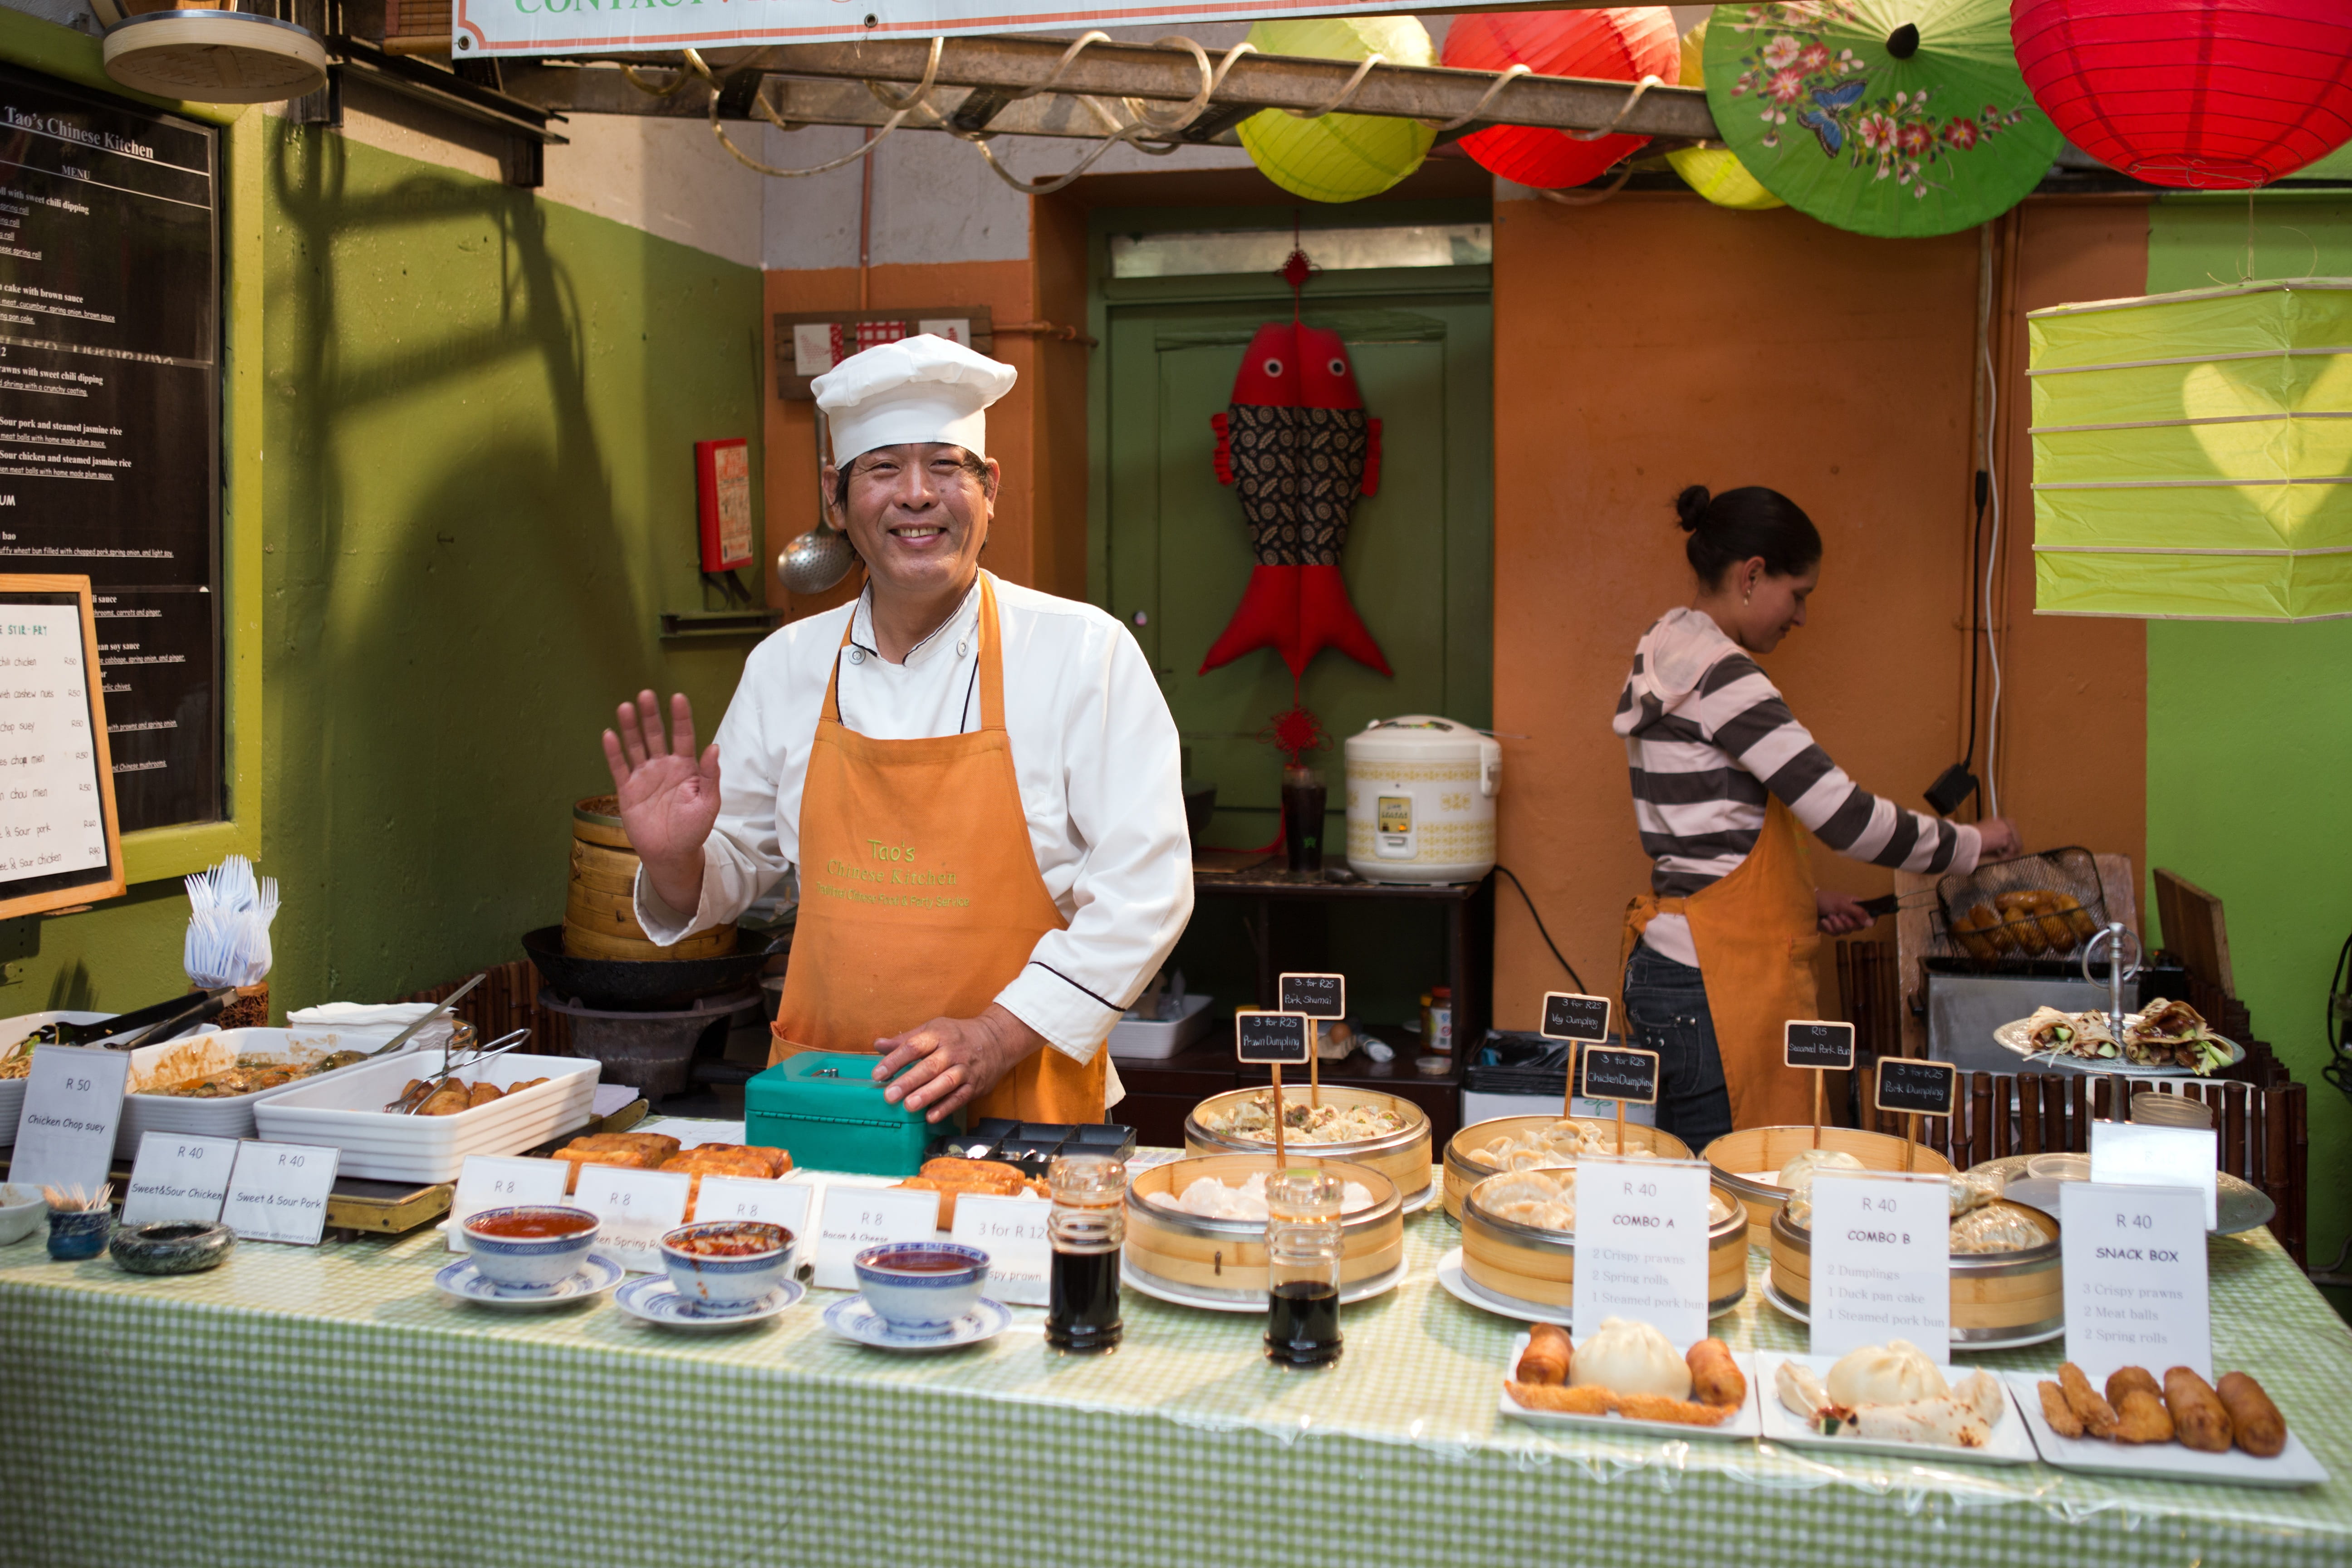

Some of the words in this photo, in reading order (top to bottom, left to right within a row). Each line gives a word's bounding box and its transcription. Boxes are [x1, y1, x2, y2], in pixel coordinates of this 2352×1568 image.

[5, 106, 43, 130] Tao's
[47, 118, 100, 145] Chinese
[105, 132, 154, 159] Kitchen
[62, 165, 90, 180] MENU
[8, 190, 24, 199] with
[26, 194, 44, 204] sweet
[46, 197, 61, 207] chili
[63, 201, 89, 215] dipping
[5, 284, 21, 294] cake
[23, 287, 39, 296] with
[41, 289, 63, 300] brown
[64, 294, 83, 303] sauce
[22, 367, 38, 376] with
[40, 370, 59, 379] sweet
[61, 372, 76, 381] chili
[78, 373, 103, 386] dipping
[18, 420, 36, 429] pork
[37, 421, 51, 429] and
[53, 423, 81, 431] steamed
[83, 424, 109, 435] jasmine
[110, 426, 122, 436] rice
[19, 452, 46, 461] chicken
[47, 455, 61, 463] and
[63, 456, 91, 465] steamed
[92, 457, 118, 467] jasmine
[119, 458, 132, 467] rice
[2, 531, 16, 540] bao
[64, 657, 77, 665] R50
[20, 722, 34, 733] suey
[15, 827, 30, 836] Sour
[37, 823, 51, 838] pork
[867, 839, 915, 862] Tao's
[827, 859, 884, 882] Chinese
[890, 869, 957, 885] Kitchen
[817, 882, 846, 899] Traditional
[847, 888, 876, 904] Chinese
[878, 893, 899, 906] Food
[901, 895, 907, 906] &
[910, 896, 934, 910] Party
[936, 895, 970, 907] Service
[1306, 979, 1317, 987] for
[1319, 980, 1334, 988] R25
[1284, 995, 1302, 1004] Pork
[1303, 996, 1332, 1005] Shumai
[1570, 1000, 1583, 1009] for
[1585, 1001, 1602, 1009] R25
[1253, 1017, 1261, 1027] 3
[1265, 1016, 1278, 1026] for
[1279, 1017, 1297, 1028] R25
[1566, 1016, 1598, 1029] Dumpling
[1812, 1026, 1827, 1036] R15
[1244, 1035, 1265, 1046] Prawn
[1267, 1036, 1299, 1051] Dumpling
[1819, 1044, 1836, 1054] Pork
[1838, 1045, 1851, 1056] Bun
[1601, 1054, 1609, 1063] 3
[1615, 1056, 1628, 1065] for
[1629, 1057, 1646, 1067] R25
[1896, 1065, 1905, 1075] 3
[1910, 1067, 1921, 1077] for
[1924, 1068, 1944, 1079] R25
[66, 1078, 74, 1089] R
[77, 1079, 90, 1092] 50
[1588, 1072, 1619, 1083] Chicken
[1619, 1074, 1654, 1093] Dumpling
[1884, 1081, 1904, 1093] Pork
[1906, 1083, 1944, 1101] Dumpling
[28, 1114, 61, 1129] Chicken
[63, 1118, 83, 1132] Chop
[85, 1121, 105, 1135] suey
[178, 1147, 186, 1159] R
[189, 1147, 204, 1159] 40
[279, 1154, 286, 1166] R
[289, 1156, 304, 1167] 40
[131, 1183, 186, 1197] Sweet&Sour
[188, 1188, 223, 1201] Chicken
[495, 1181, 503, 1193] R
[507, 1181, 515, 1193] 8
[1624, 1183, 1633, 1195] R
[1639, 1184, 1656, 1197] 40
[236, 1192, 265, 1203] Sweet
[267, 1195, 274, 1204] &
[276, 1196, 298, 1207] Sour
[300, 1197, 322, 1210] Pork
[610, 1193, 619, 1205] R
[623, 1193, 632, 1205] 8
[1862, 1197, 1872, 1211] R
[1878, 1199, 1897, 1213] 40
[737, 1205, 745, 1216] R
[750, 1205, 758, 1217] 8
[862, 1212, 869, 1224] R
[875, 1213, 882, 1225] 8
[1613, 1215, 1660, 1228] COMBO
[1666, 1218, 1675, 1229] A
[2116, 1214, 2127, 1228] R
[2132, 1215, 2152, 1229] 40
[823, 1231, 847, 1241] Bacon
[859, 1233, 889, 1243] Cheese
[978, 1224, 985, 1235] 3
[991, 1223, 1009, 1237] for
[1015, 1226, 1024, 1238] R
[1029, 1227, 1045, 1240] 12
[1847, 1230, 1896, 1244] COMBO
[1903, 1234, 1911, 1245] B
[613, 1237, 646, 1251] Spring
[1592, 1249, 1600, 1259] 2
[1603, 1250, 1641, 1263] Crispy
[1645, 1254, 1686, 1265] prawns
[2096, 1248, 2143, 1260] SNACK
[2150, 1250, 2179, 1263] BOX
[1009, 1271, 1042, 1282] prawn
[1592, 1271, 1599, 1280] 2
[1603, 1271, 1640, 1284] Spring
[1644, 1275, 1669, 1285] rolls
[1828, 1264, 1834, 1275] 2
[1838, 1265, 1900, 1280] Dumplings
[1828, 1287, 1833, 1297] 1
[1838, 1287, 1868, 1300] Duck
[1872, 1292, 1893, 1303] pan
[1898, 1292, 1926, 1304] cake
[2083, 1284, 2091, 1294] 3
[2095, 1284, 2134, 1298] Crispy
[2139, 1288, 2183, 1300] prawns
[1592, 1292, 1597, 1302] 1
[1602, 1293, 1651, 1307] Steamed
[1654, 1296, 1681, 1308] pork
[1684, 1298, 1705, 1310] bun
[1828, 1309, 1833, 1319] 1
[1838, 1309, 1888, 1323] Steamed
[1892, 1313, 1920, 1326] pork
[1923, 1316, 1945, 1328] bun
[2083, 1307, 2091, 1317] 2
[2095, 1307, 2126, 1319] Meat
[2131, 1308, 2159, 1321] balls
[2084, 1329, 2092, 1339] 2
[2097, 1330, 2136, 1343] Spring
[2141, 1333, 2168, 1343] rolls
